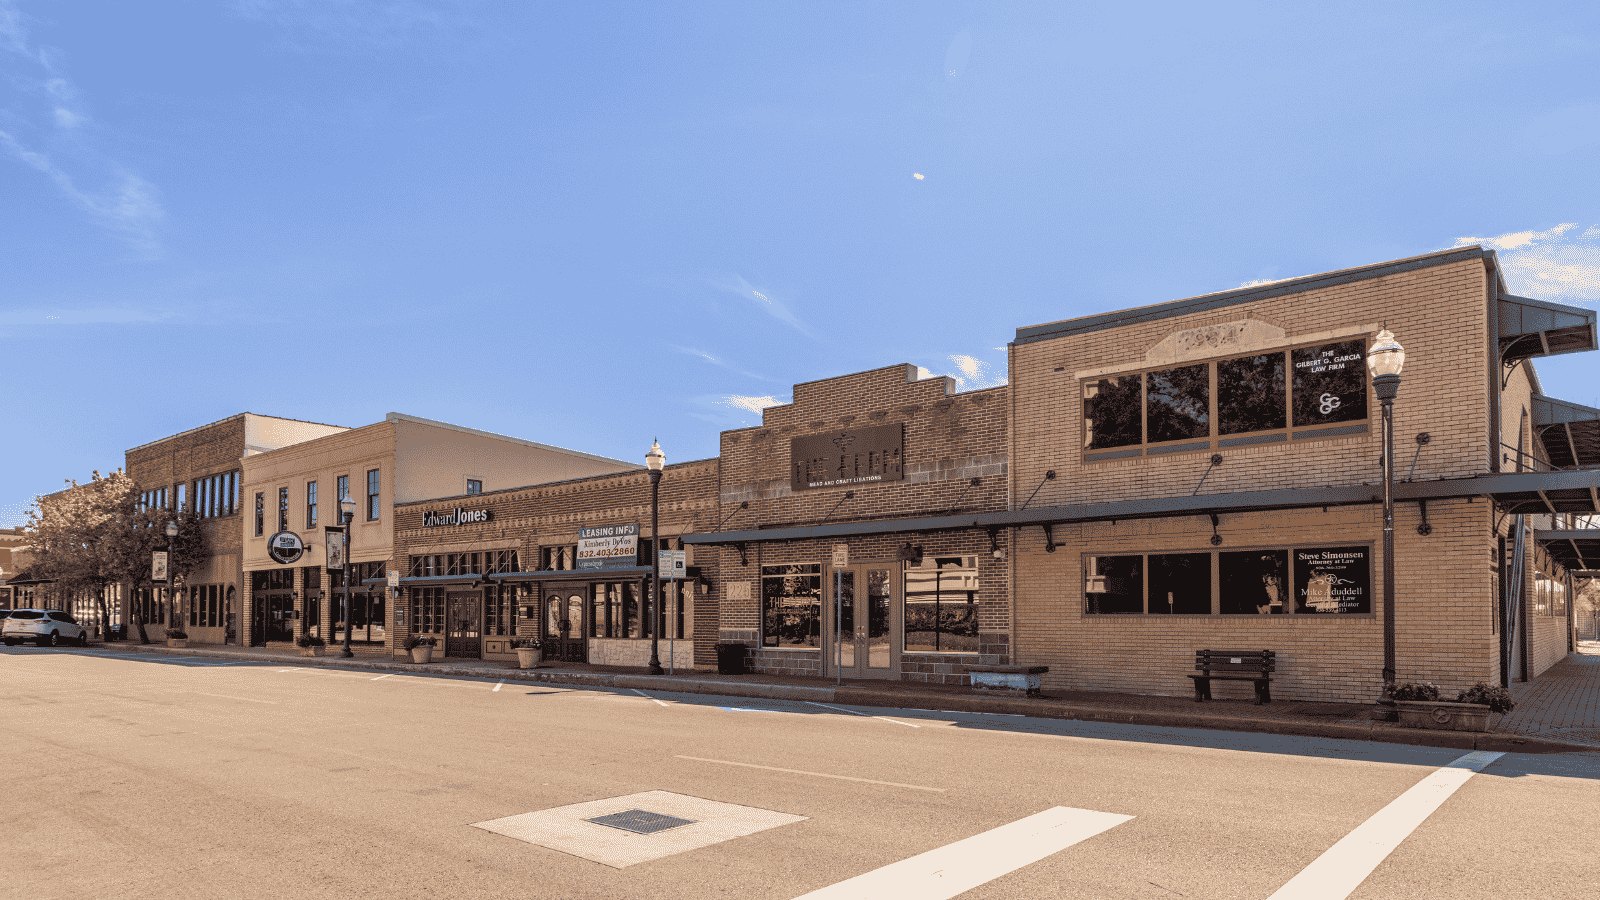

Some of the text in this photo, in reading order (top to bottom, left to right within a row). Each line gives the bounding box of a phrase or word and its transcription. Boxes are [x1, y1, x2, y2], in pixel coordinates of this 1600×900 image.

[1296, 359, 1321, 368] GILBERT
[1334, 353, 1361, 362] GARCIA
[456, 508, 487, 525] Jones
[582, 525, 634, 537] LEASING INFO
[1298, 551, 1364, 560] Steve Simonsen
[1301, 588, 1323, 596] Mike
